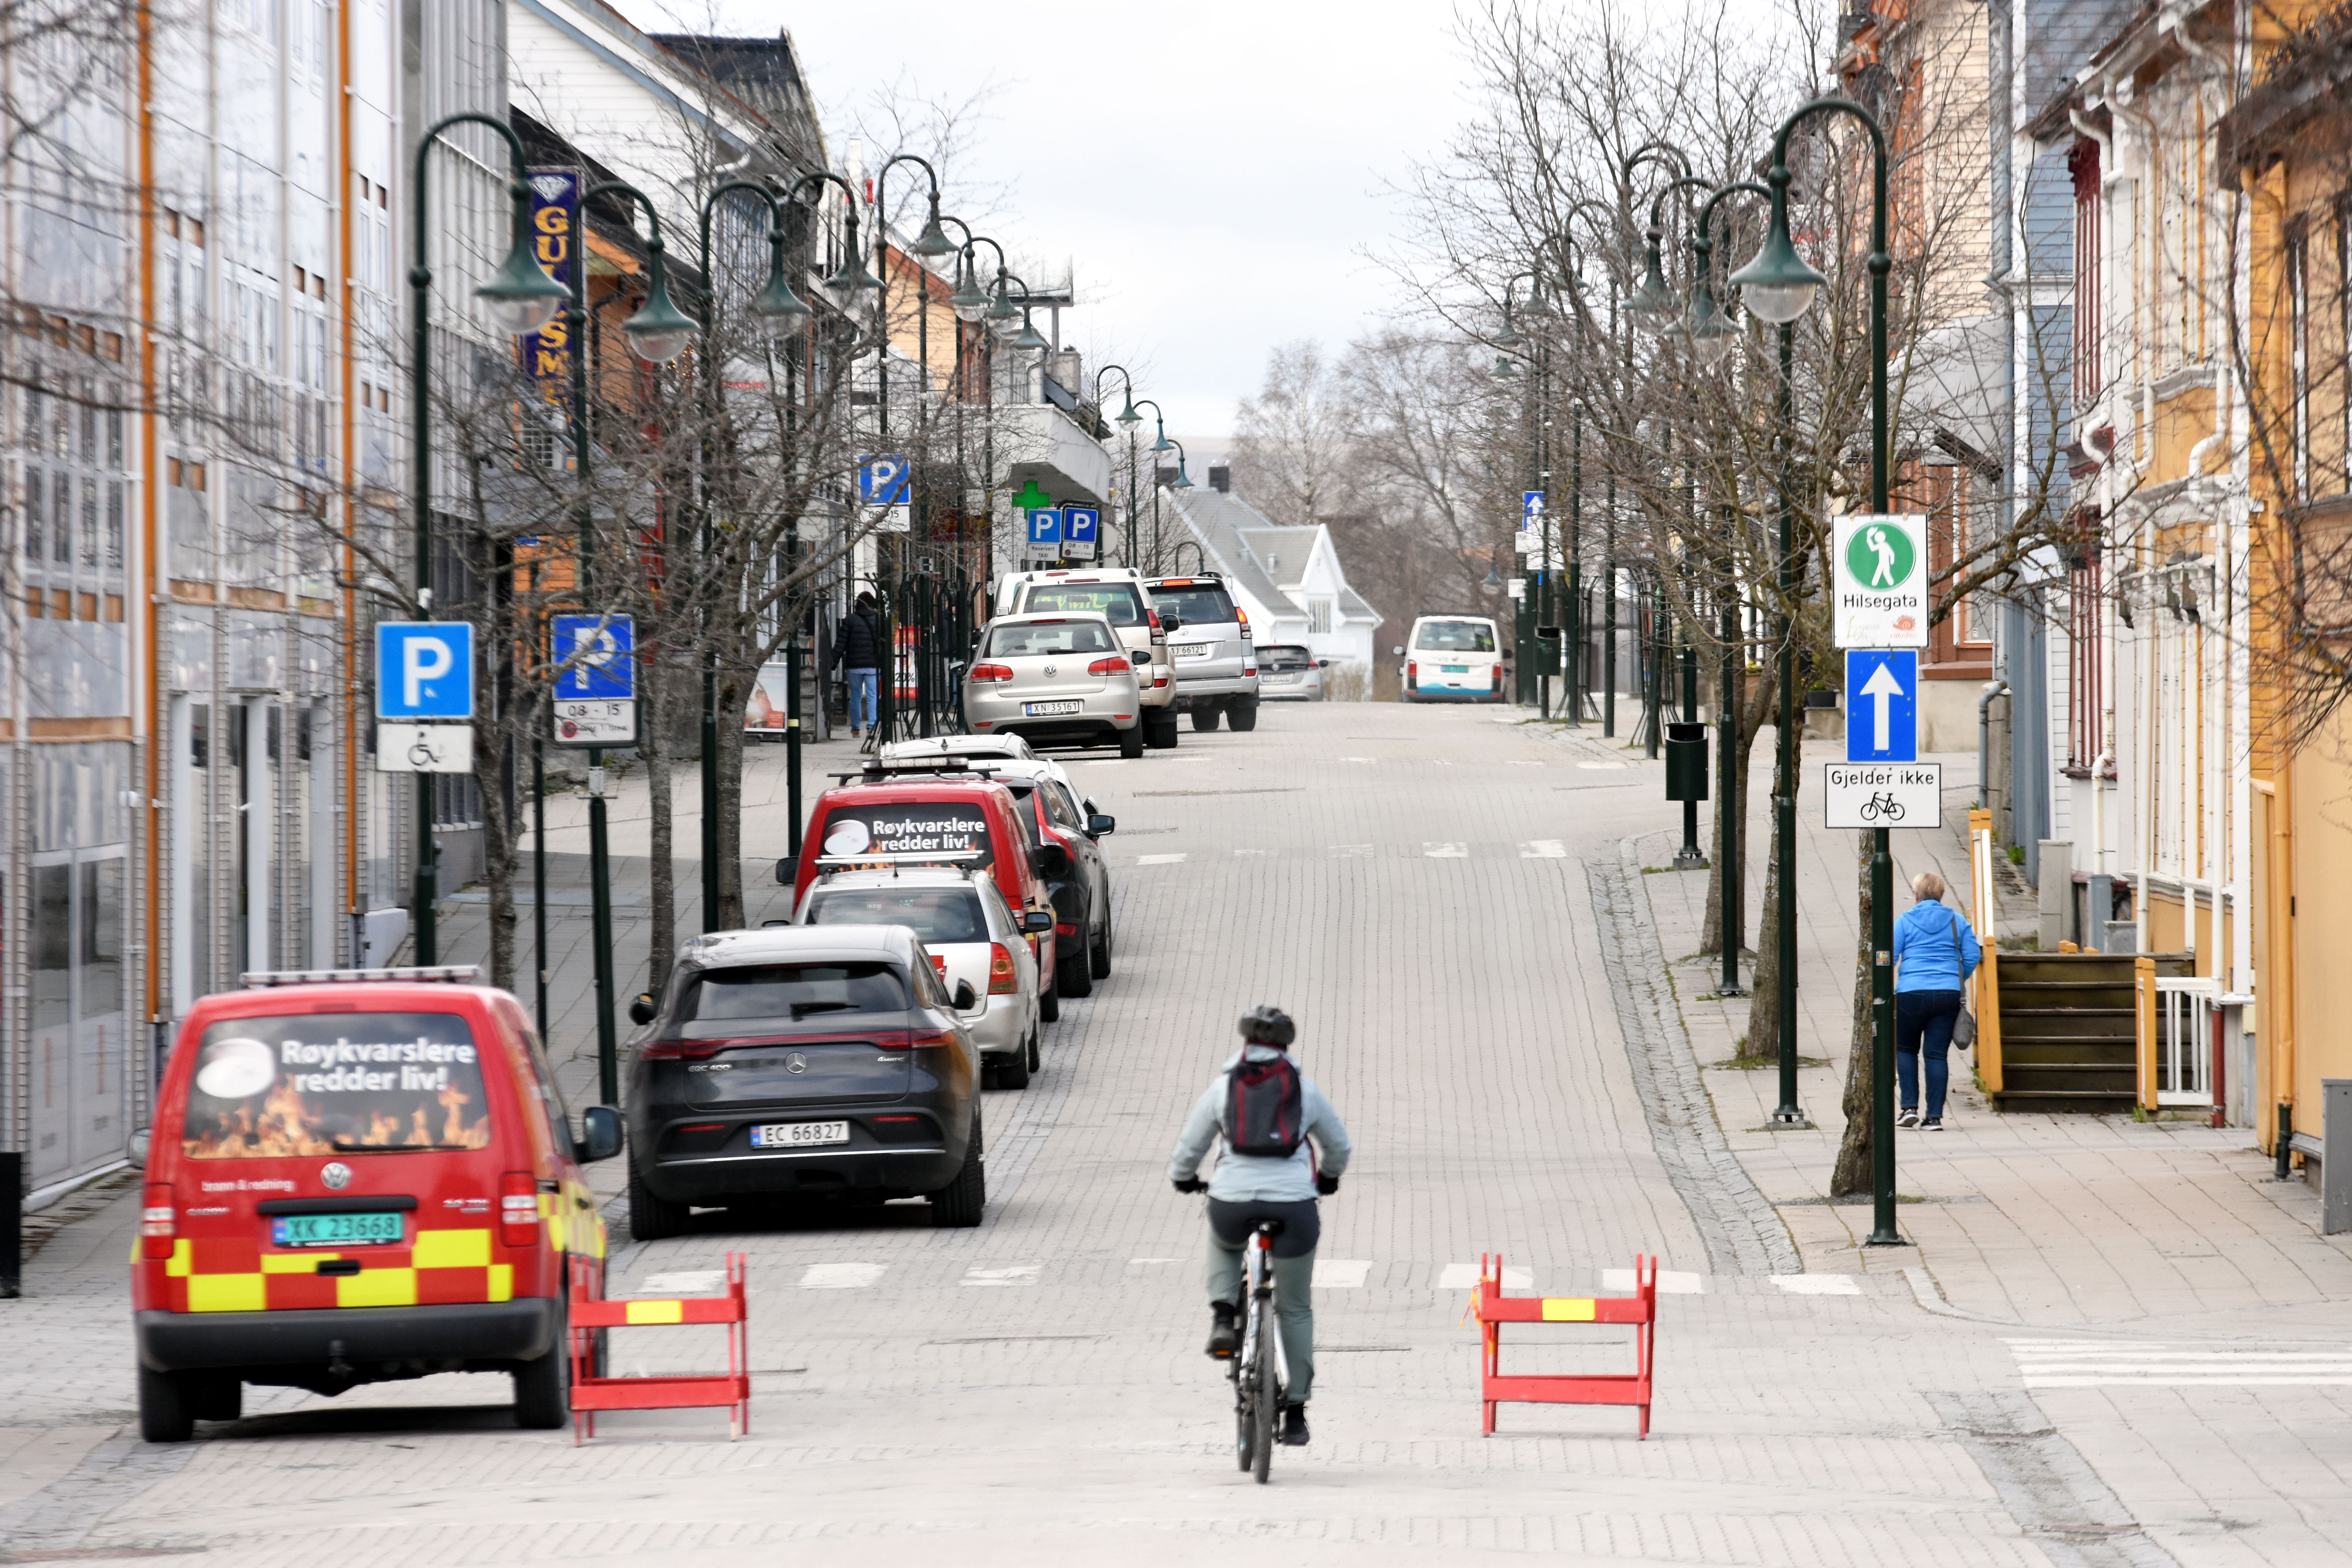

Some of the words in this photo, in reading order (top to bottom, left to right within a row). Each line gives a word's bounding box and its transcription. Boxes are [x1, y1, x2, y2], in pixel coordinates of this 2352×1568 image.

[1036, 514, 1053, 539] P
[1073, 514, 1090, 537] P
[1844, 593, 1917, 611] Hilsegata
[575, 628, 616, 689] P
[403, 637, 453, 707] P
[568, 705, 586, 716] 08
[607, 704, 619, 715] 15
[1051, 702, 1076, 711] 35161
[1831, 771, 1892, 789] Gjelder
[1900, 771, 1934, 784] ikke
[873, 817, 985, 837] Røykvarslere
[882, 835, 939, 851] redder
[943, 834, 969, 849] liv!
[281, 1037, 476, 1069] Røykvarslere
[295, 1065, 397, 1092] redder
[401, 1065, 449, 1091] liv!
[766, 1127, 784, 1142] EC
[792, 1124, 842, 1141] 66827
[201, 1181, 235, 1192] brann
[248, 1179, 295, 1192] redning
[288, 1220, 316, 1239] XK
[328, 1216, 396, 1238] 23668
